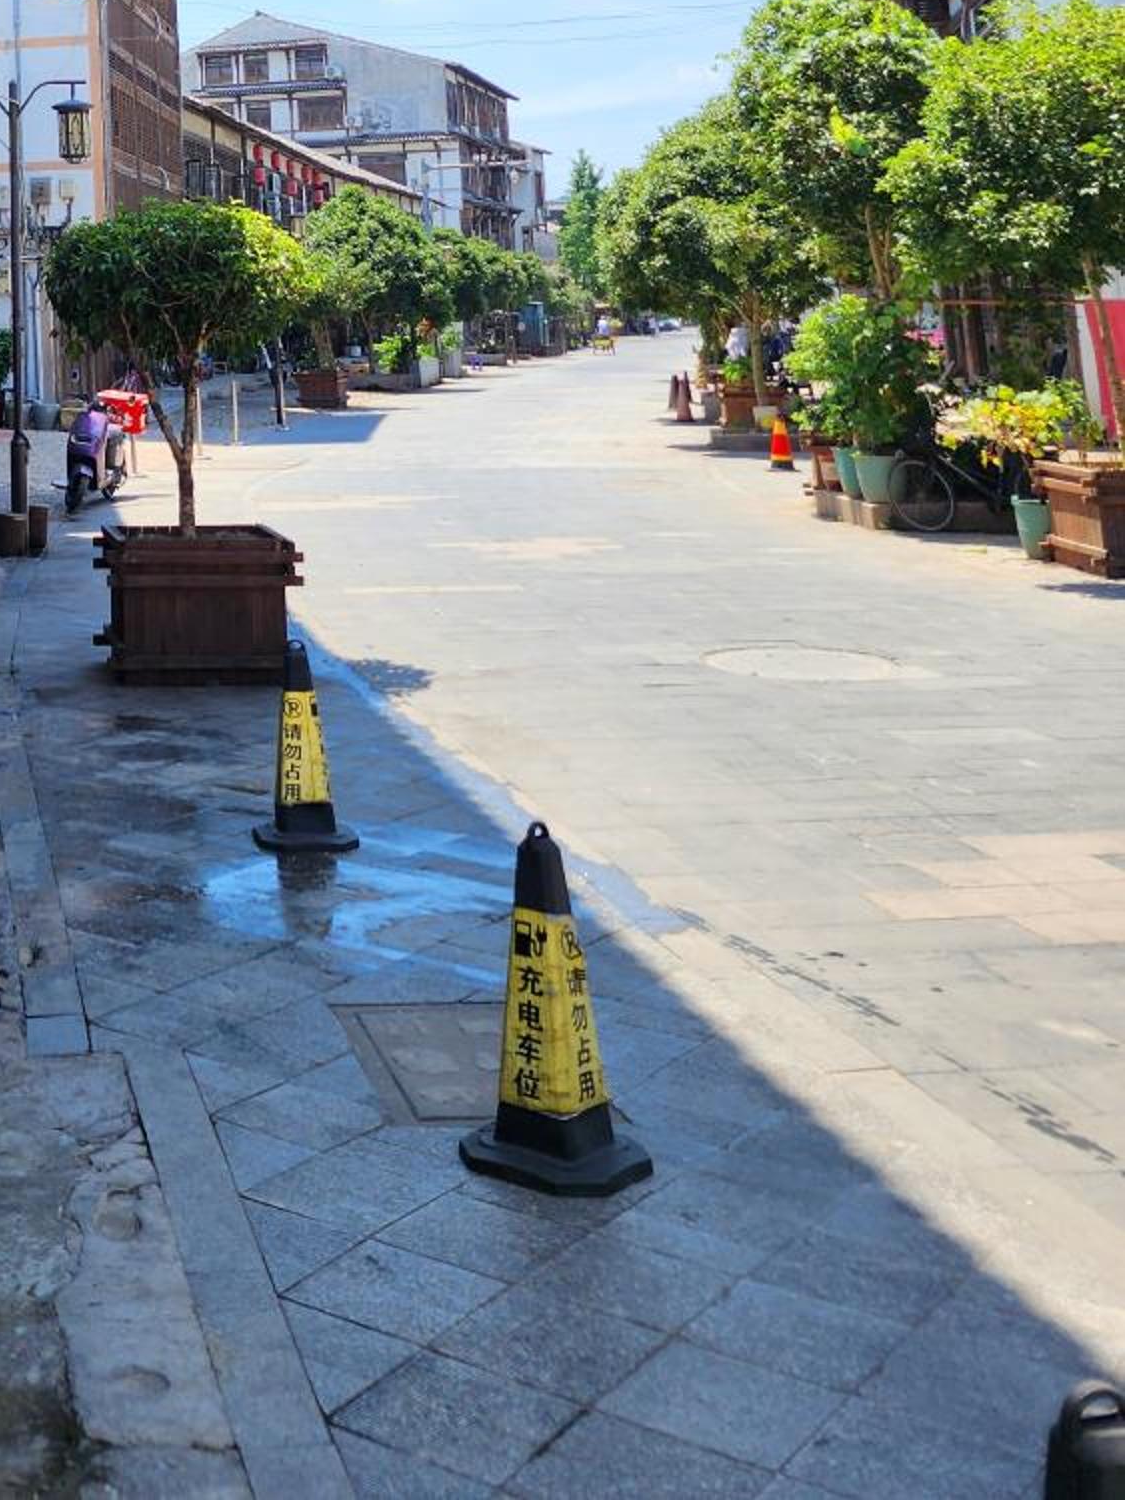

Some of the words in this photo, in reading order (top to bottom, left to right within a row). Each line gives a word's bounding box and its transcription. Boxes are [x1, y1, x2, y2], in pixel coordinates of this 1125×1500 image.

[283, 723, 301, 801] 请勿占用
[514, 965, 543, 1100] 充电车位
[566, 969, 595, 1102] 请勿占用
